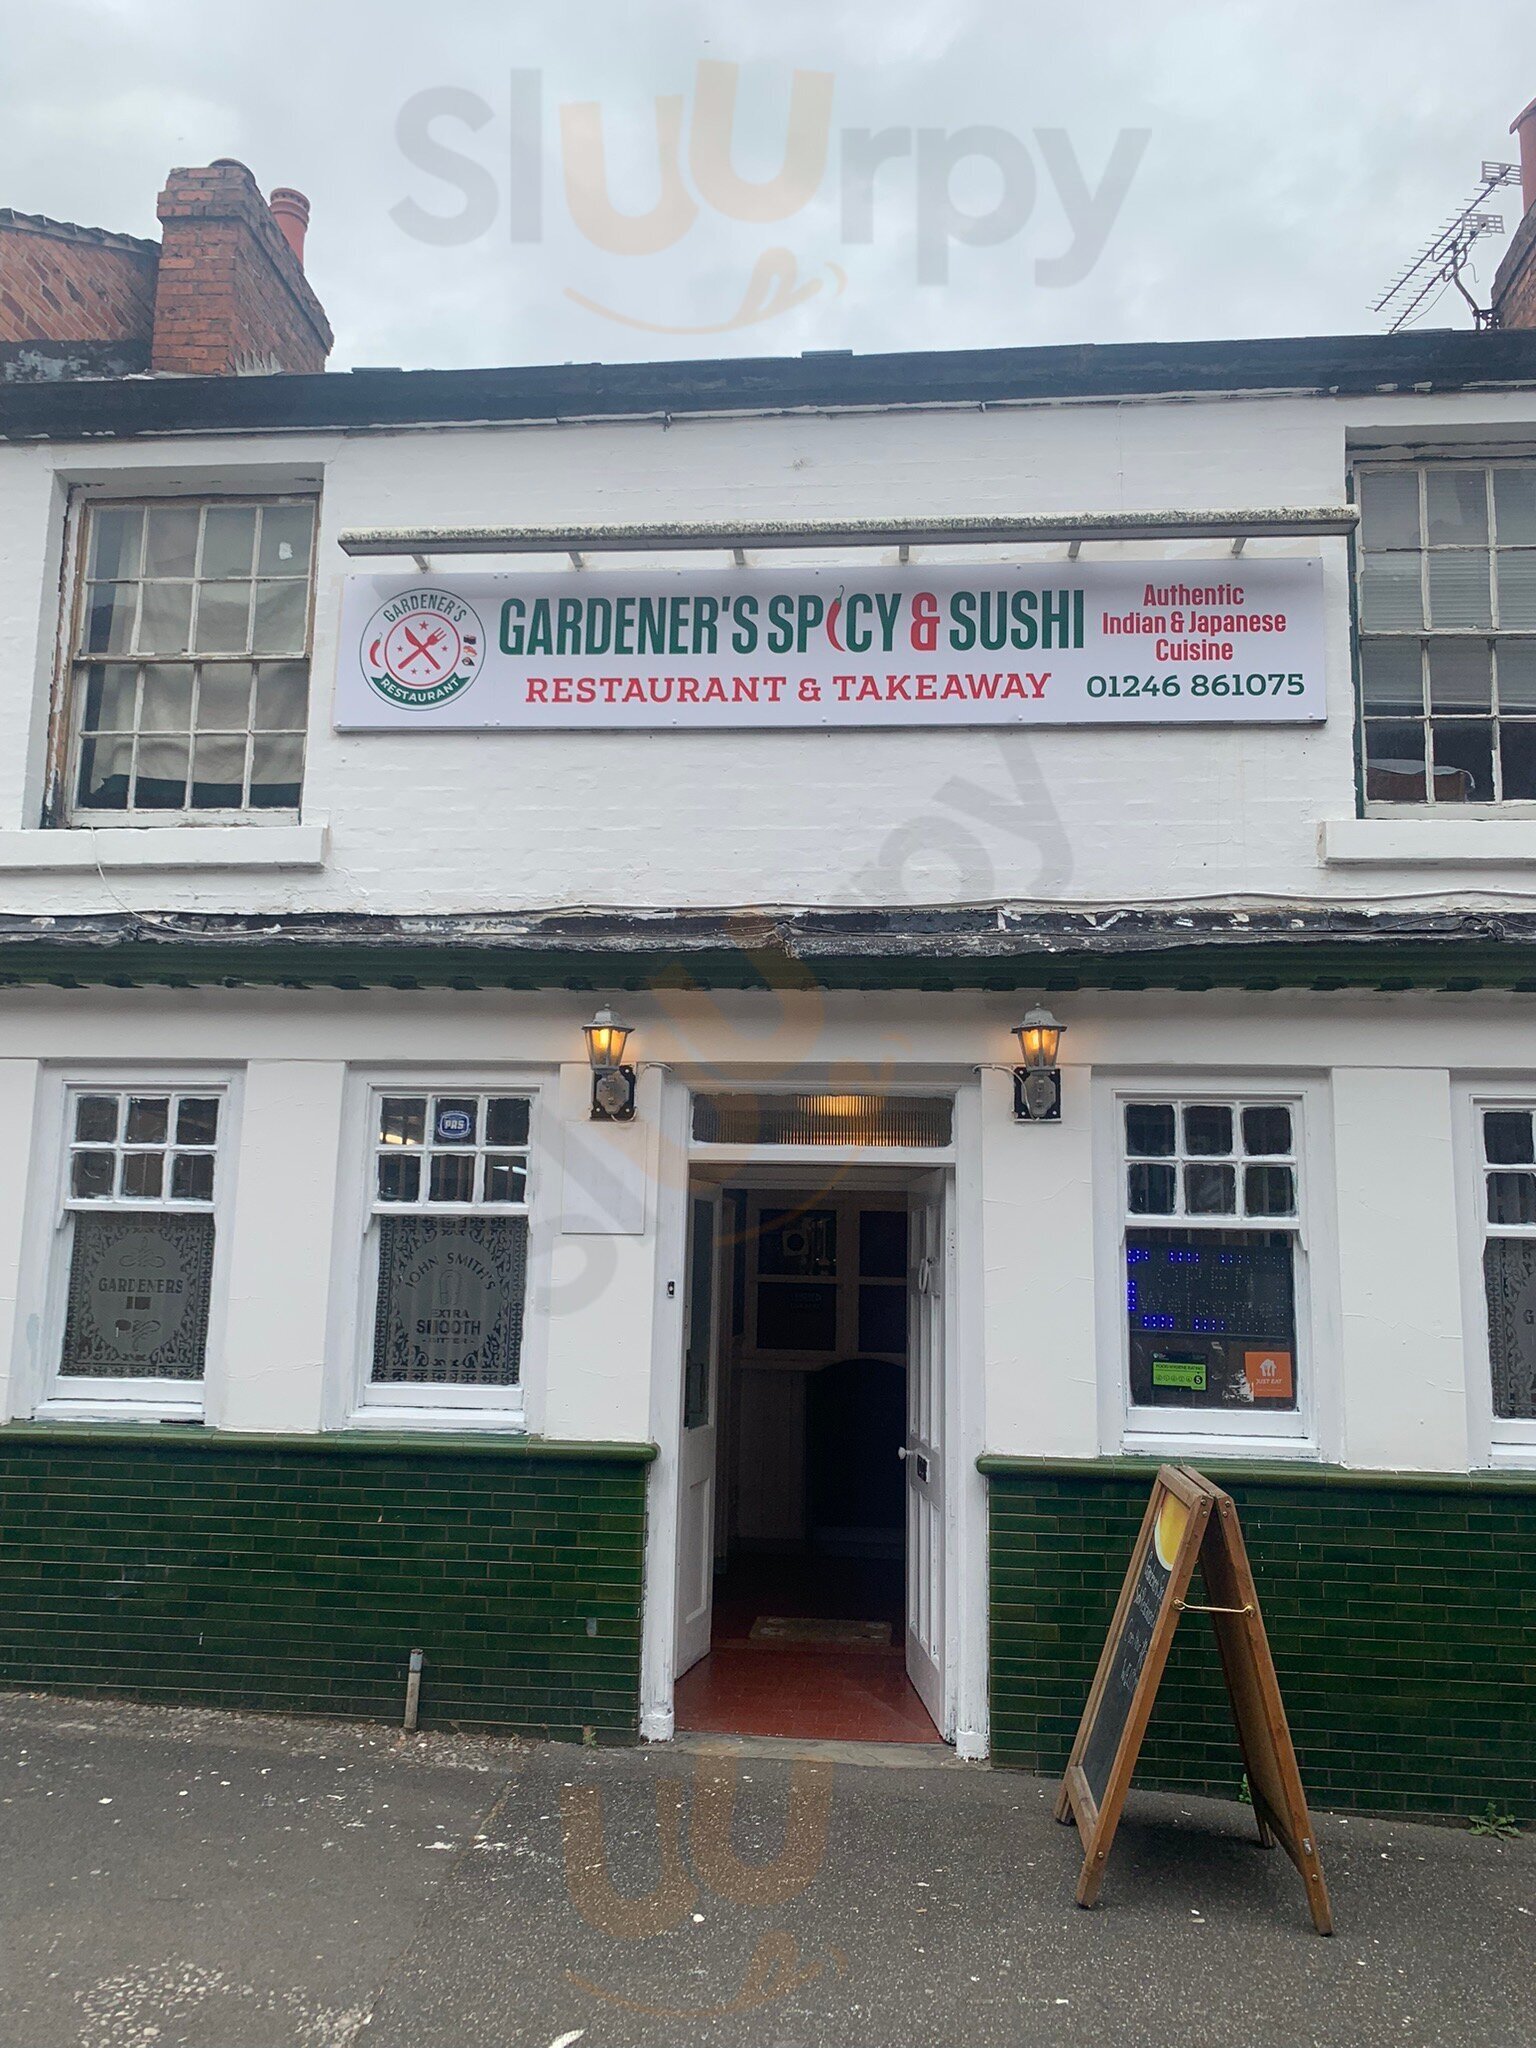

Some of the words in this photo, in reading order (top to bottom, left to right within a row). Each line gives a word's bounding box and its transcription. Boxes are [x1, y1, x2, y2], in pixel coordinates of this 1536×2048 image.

[383, 593, 467, 623] GARDENER'S
[1144, 584, 1244, 607] Authentic
[498, 596, 759, 656] GARDENER'S
[909, 591, 942, 652] &
[948, 588, 1086, 652] SUSHI
[1102, 612, 1166, 635] Indian
[1170, 612, 1184, 633] &
[1189, 611, 1287, 637] Japanese
[1155, 639, 1234, 662] Cuisine
[380, 678, 460, 703] RESTAURANT
[525, 676, 787, 704] RESTAURANT
[797, 677, 822, 703] &
[832, 672, 1053, 702] TAKEAWAY
[1085, 671, 1182, 699] 01246
[1190, 671, 1306, 698] 861075
[404, 1255, 440, 1290] JOHN
[446, 1251, 497, 1290] SMITH'S
[1157, 1264, 1255, 1291] OPEN
[98, 1277, 184, 1294] GARDENERS
[430, 1308, 470, 1319] EXTRA
